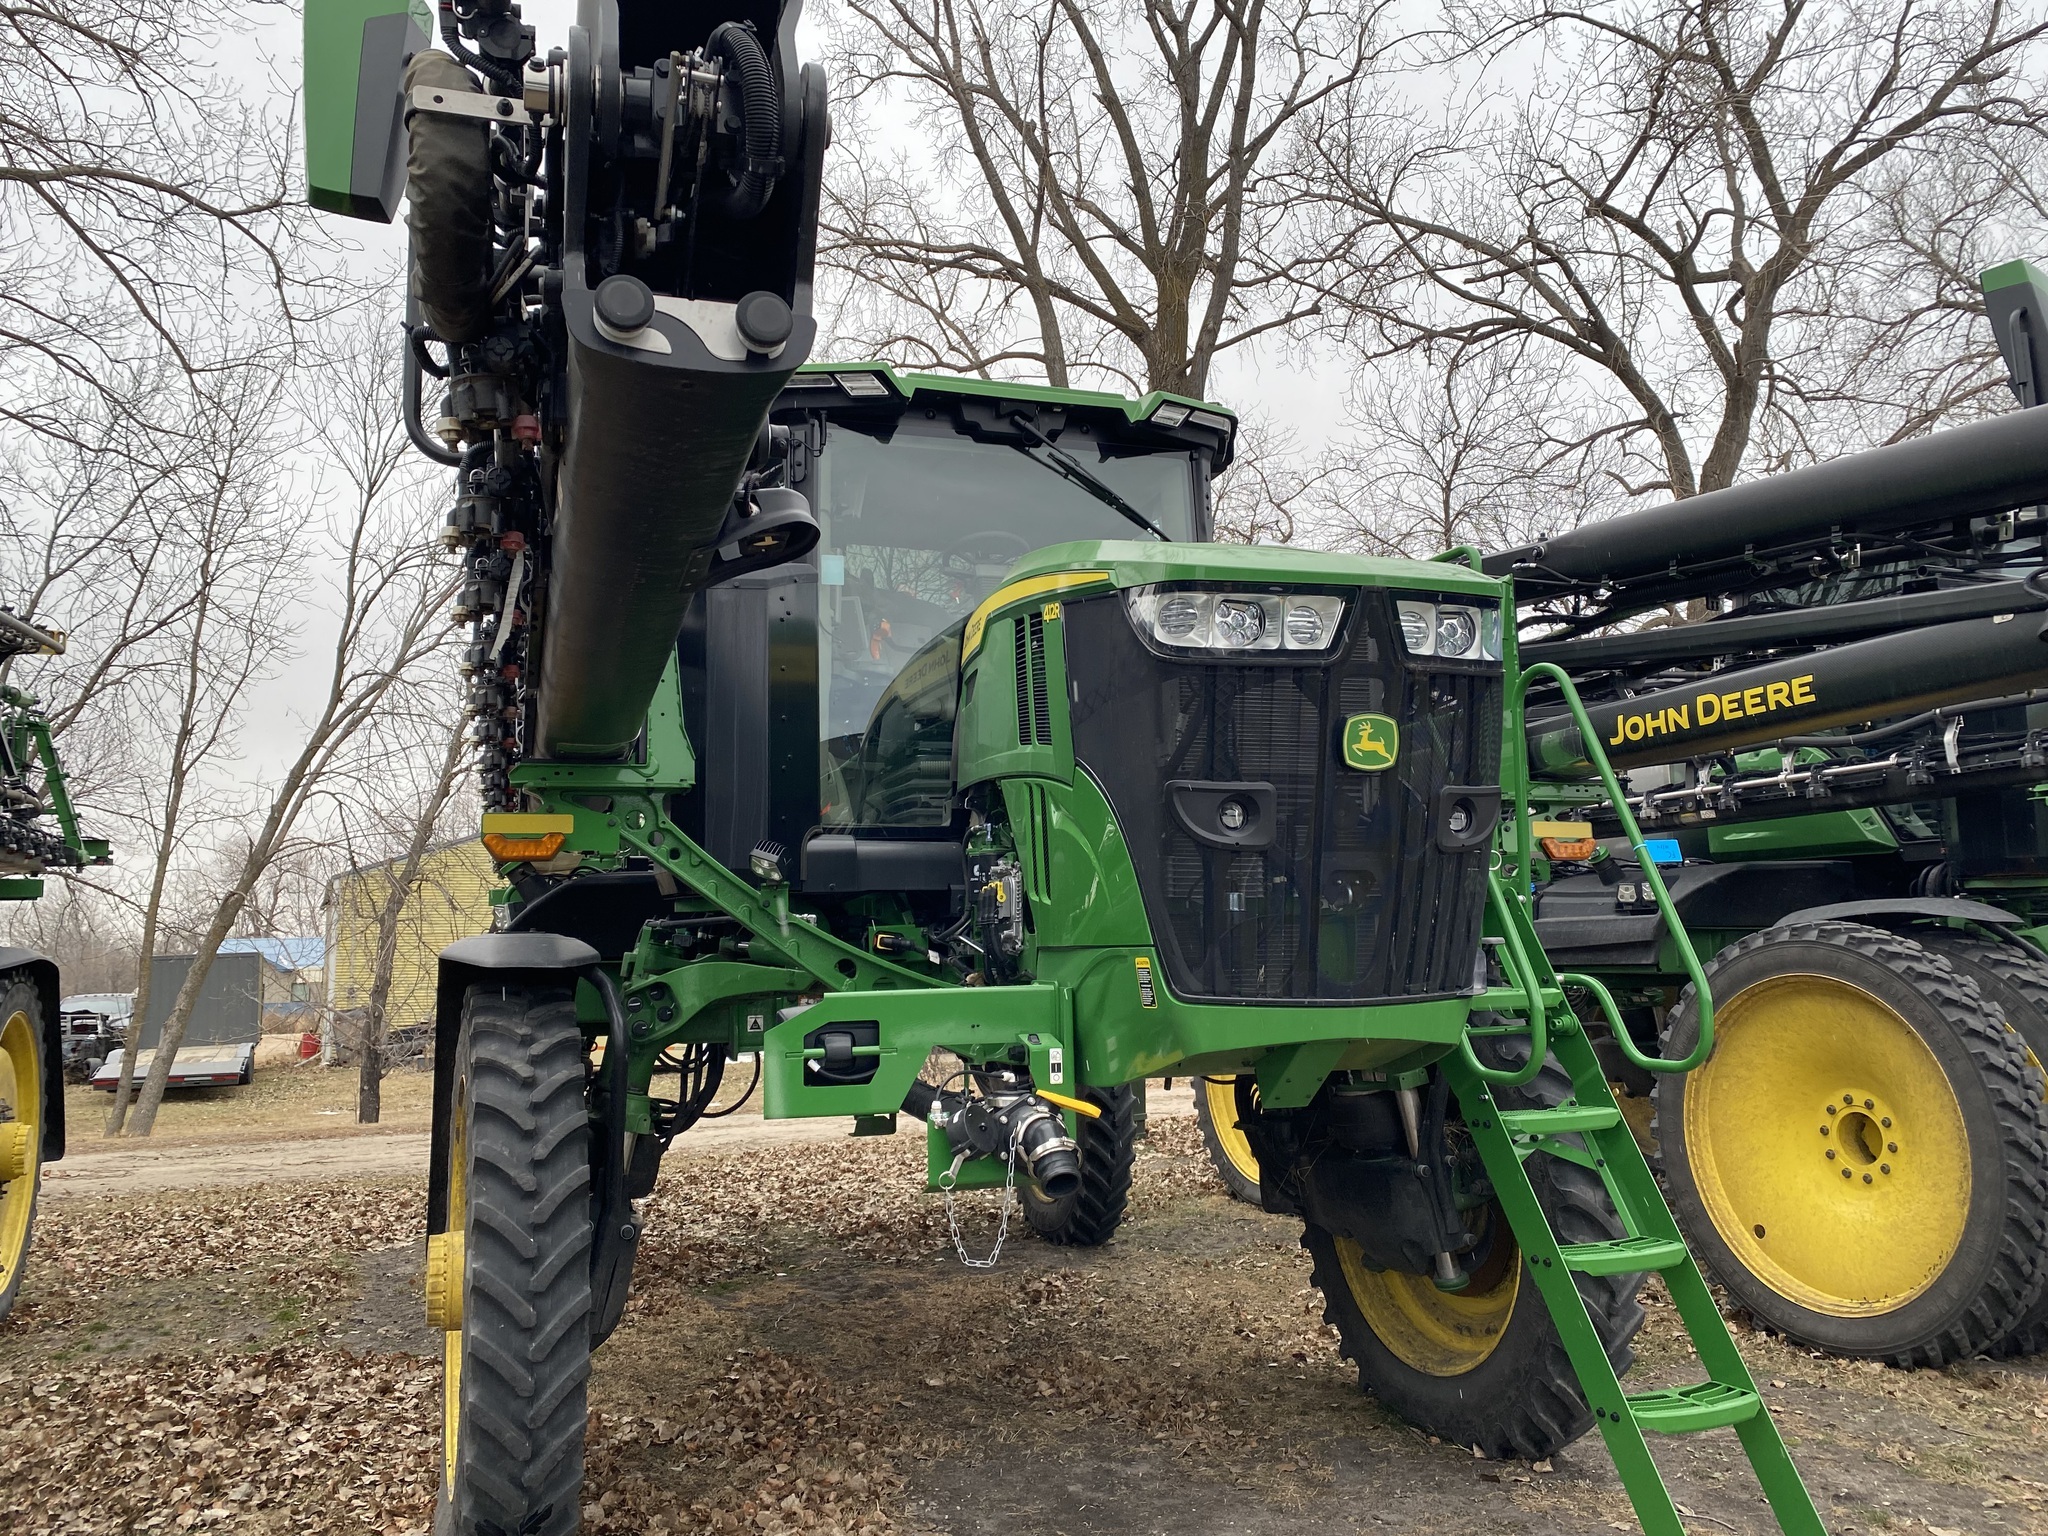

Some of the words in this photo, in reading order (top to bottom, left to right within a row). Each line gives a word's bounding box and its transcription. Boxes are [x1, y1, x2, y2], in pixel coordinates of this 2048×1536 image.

[1043, 602, 1060, 623] 412R
[1609, 703, 1690, 746] JOHN
[1695, 674, 1817, 726] DEERE
